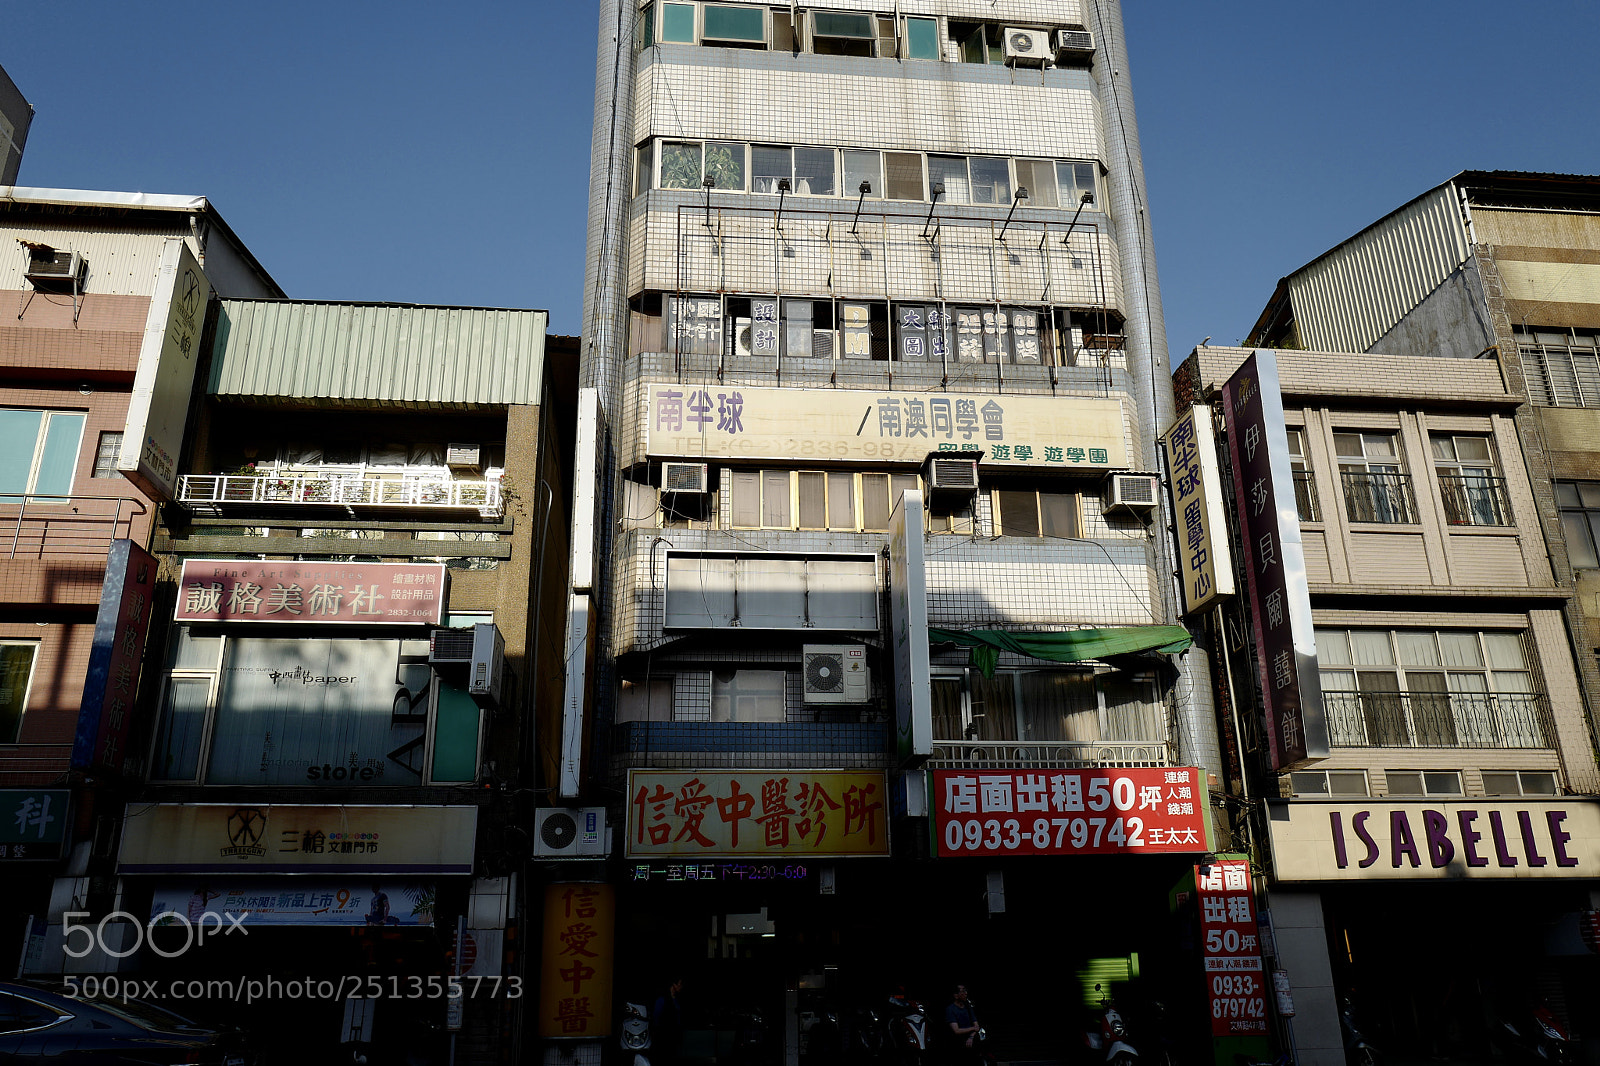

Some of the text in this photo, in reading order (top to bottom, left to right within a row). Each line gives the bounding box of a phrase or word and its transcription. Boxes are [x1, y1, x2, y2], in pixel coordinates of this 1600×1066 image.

[754, 302, 779, 350] 設計
[655, 388, 745, 435] 南半球
[1169, 414, 1212, 601] 南半球 留學中心
[213, 567, 364, 583] Fine Art Supplies
[392, 573, 436, 586] 繪畫材料
[184, 581, 386, 617] 誠格美術社
[390, 588, 434, 601] 設計用品
[387, 608, 433, 618] 2832-1064
[102, 589, 146, 769] 誠格美術社
[306, 763, 375, 781] store
[944, 774, 1163, 814] 店面出租50坪
[1166, 786, 1192, 800] 人潮
[14, 794, 55, 839] 科
[633, 777, 884, 849] 信愛中醫診所
[279, 830, 327, 854] 三槍
[945, 816, 1145, 851] 0933-879742
[1148, 826, 1199, 846] 王太太
[1329, 809, 1579, 869] ISABELLE
[1201, 864, 1248, 892] 店面
[1203, 896, 1253, 924] 出租
[1206, 929, 1257, 953] 50坪
[553, 887, 600, 1034] 信愛中醫
[1213, 975, 1260, 996] 0933-
[1212, 997, 1265, 1019] 879742
